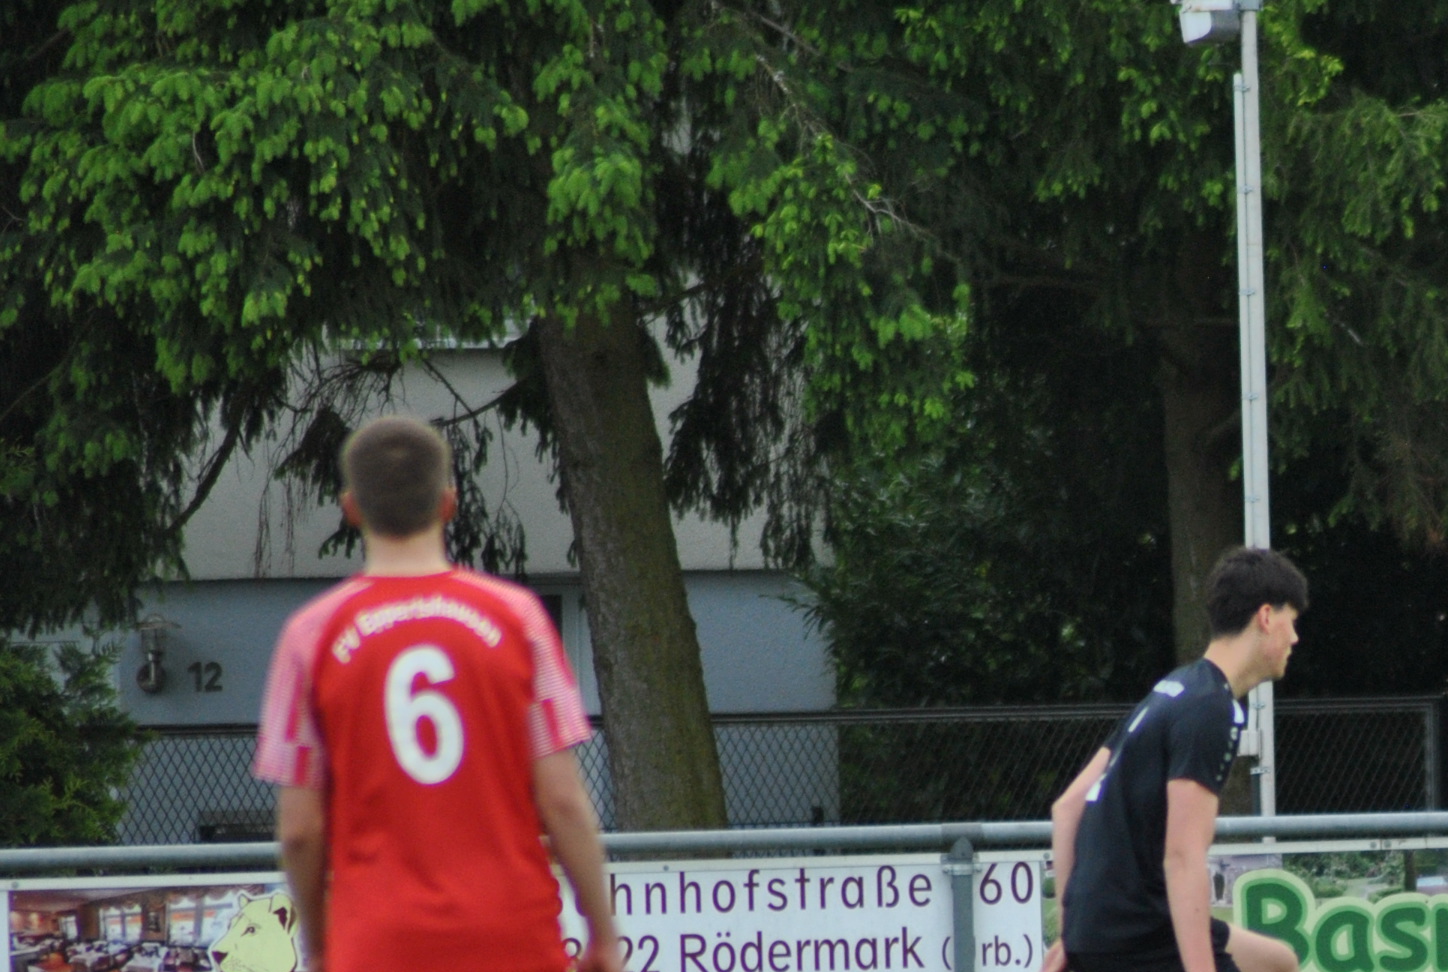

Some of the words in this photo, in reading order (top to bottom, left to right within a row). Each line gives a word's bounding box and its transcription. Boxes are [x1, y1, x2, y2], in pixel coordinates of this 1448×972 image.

[187, 661, 223, 693] 12
[384, 642, 464, 785] 6
[610, 864, 933, 916] hnhofstraße
[979, 861, 1034, 905] 60
[941, 933, 1034, 972] (rb.)
